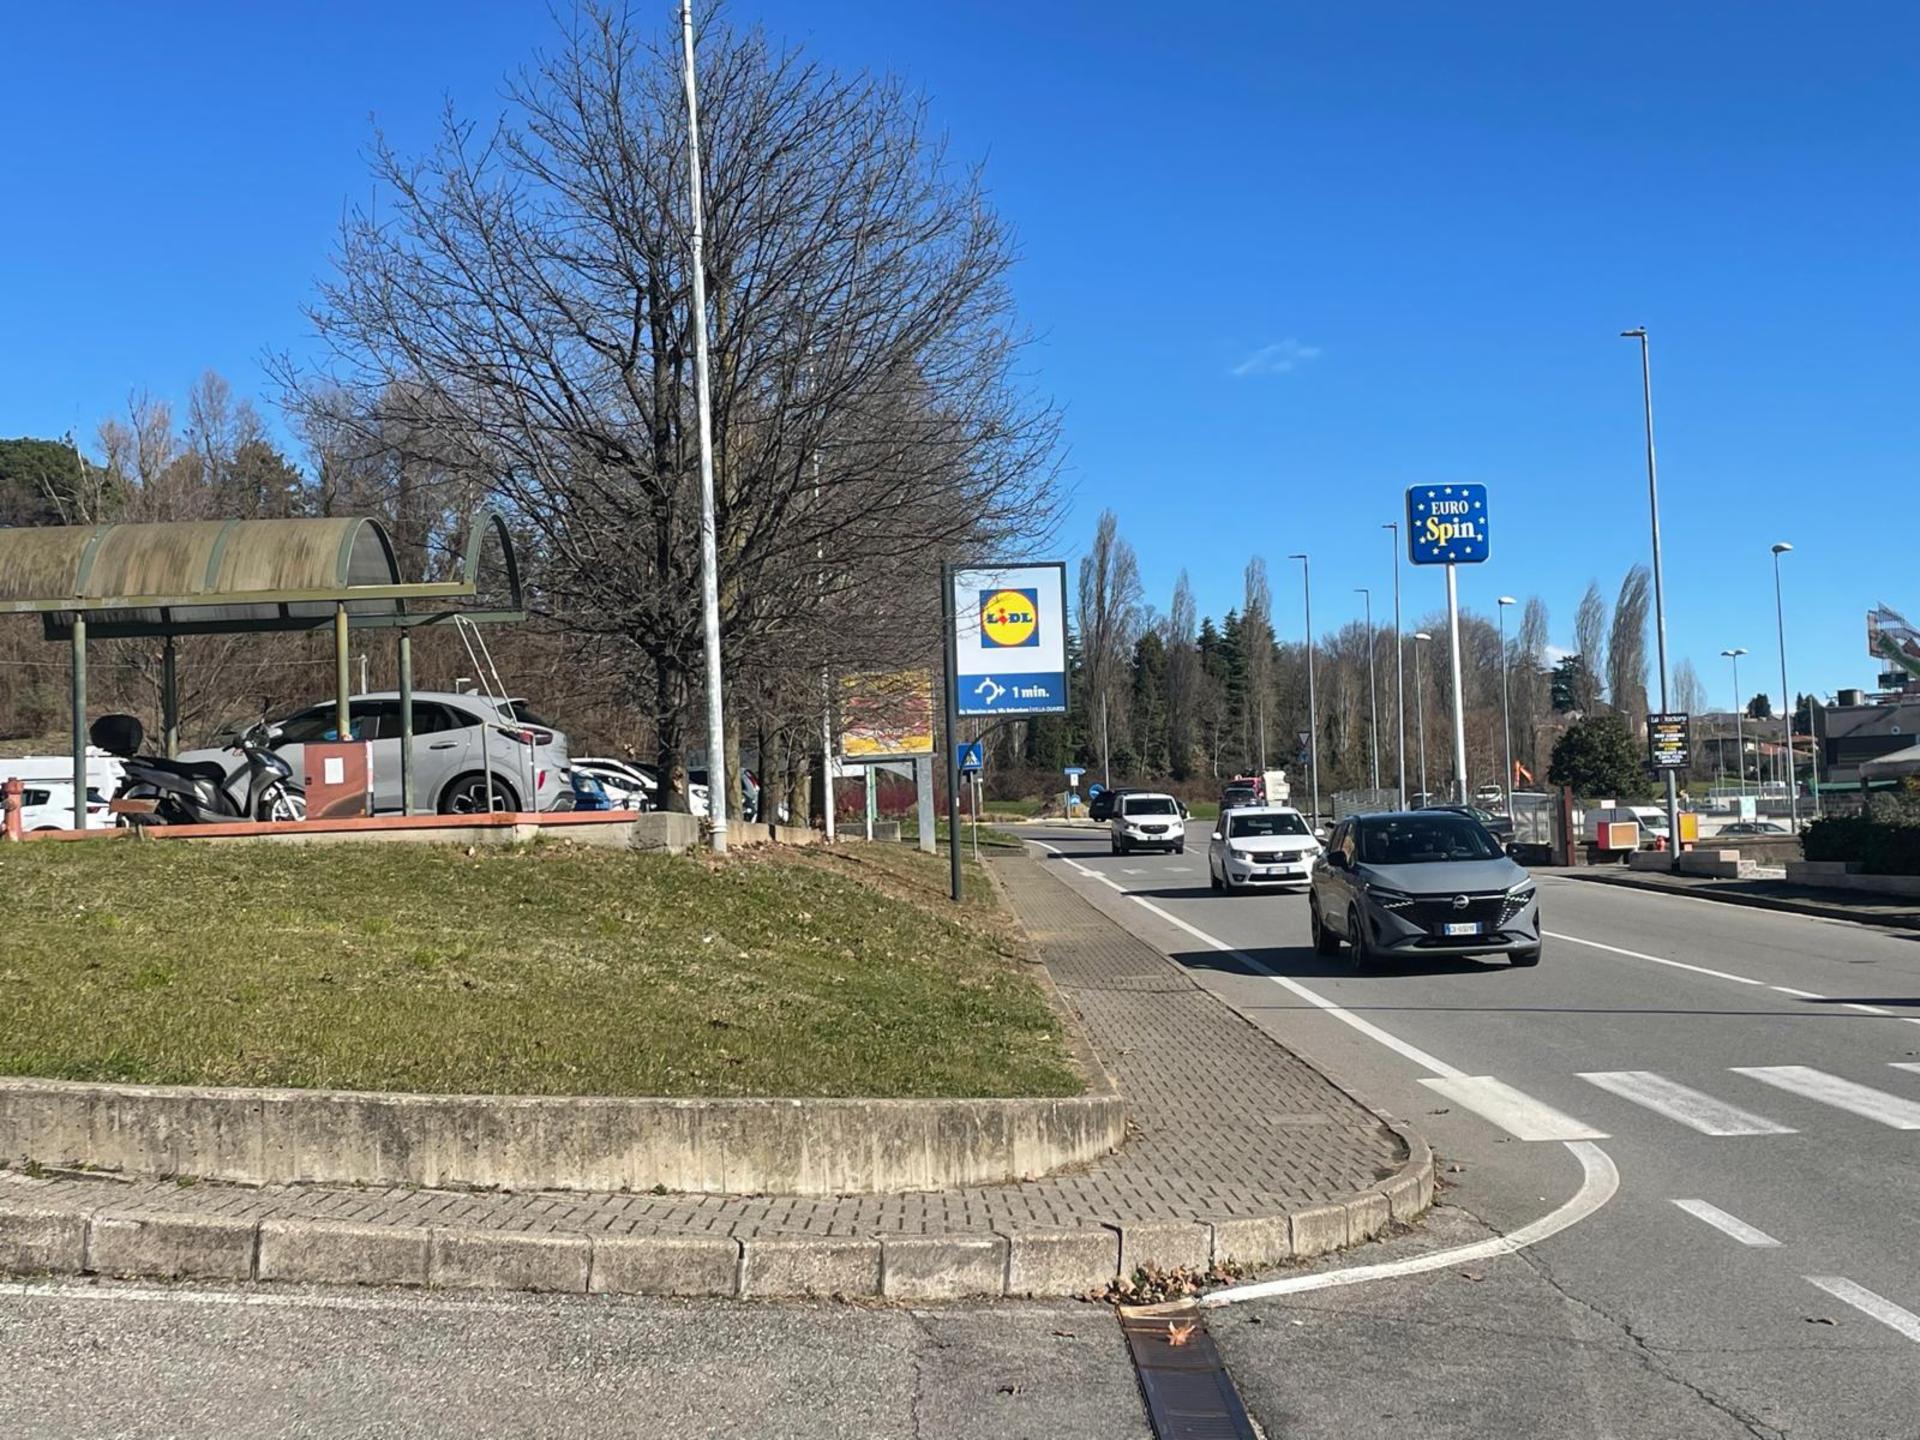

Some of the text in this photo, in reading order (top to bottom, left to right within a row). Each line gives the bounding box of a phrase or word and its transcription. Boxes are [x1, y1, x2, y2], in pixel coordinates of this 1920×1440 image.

[1431, 500, 1469, 515] EURO
[1426, 516, 1476, 546] Spin
[1012, 685, 1050, 698] 1 min.
